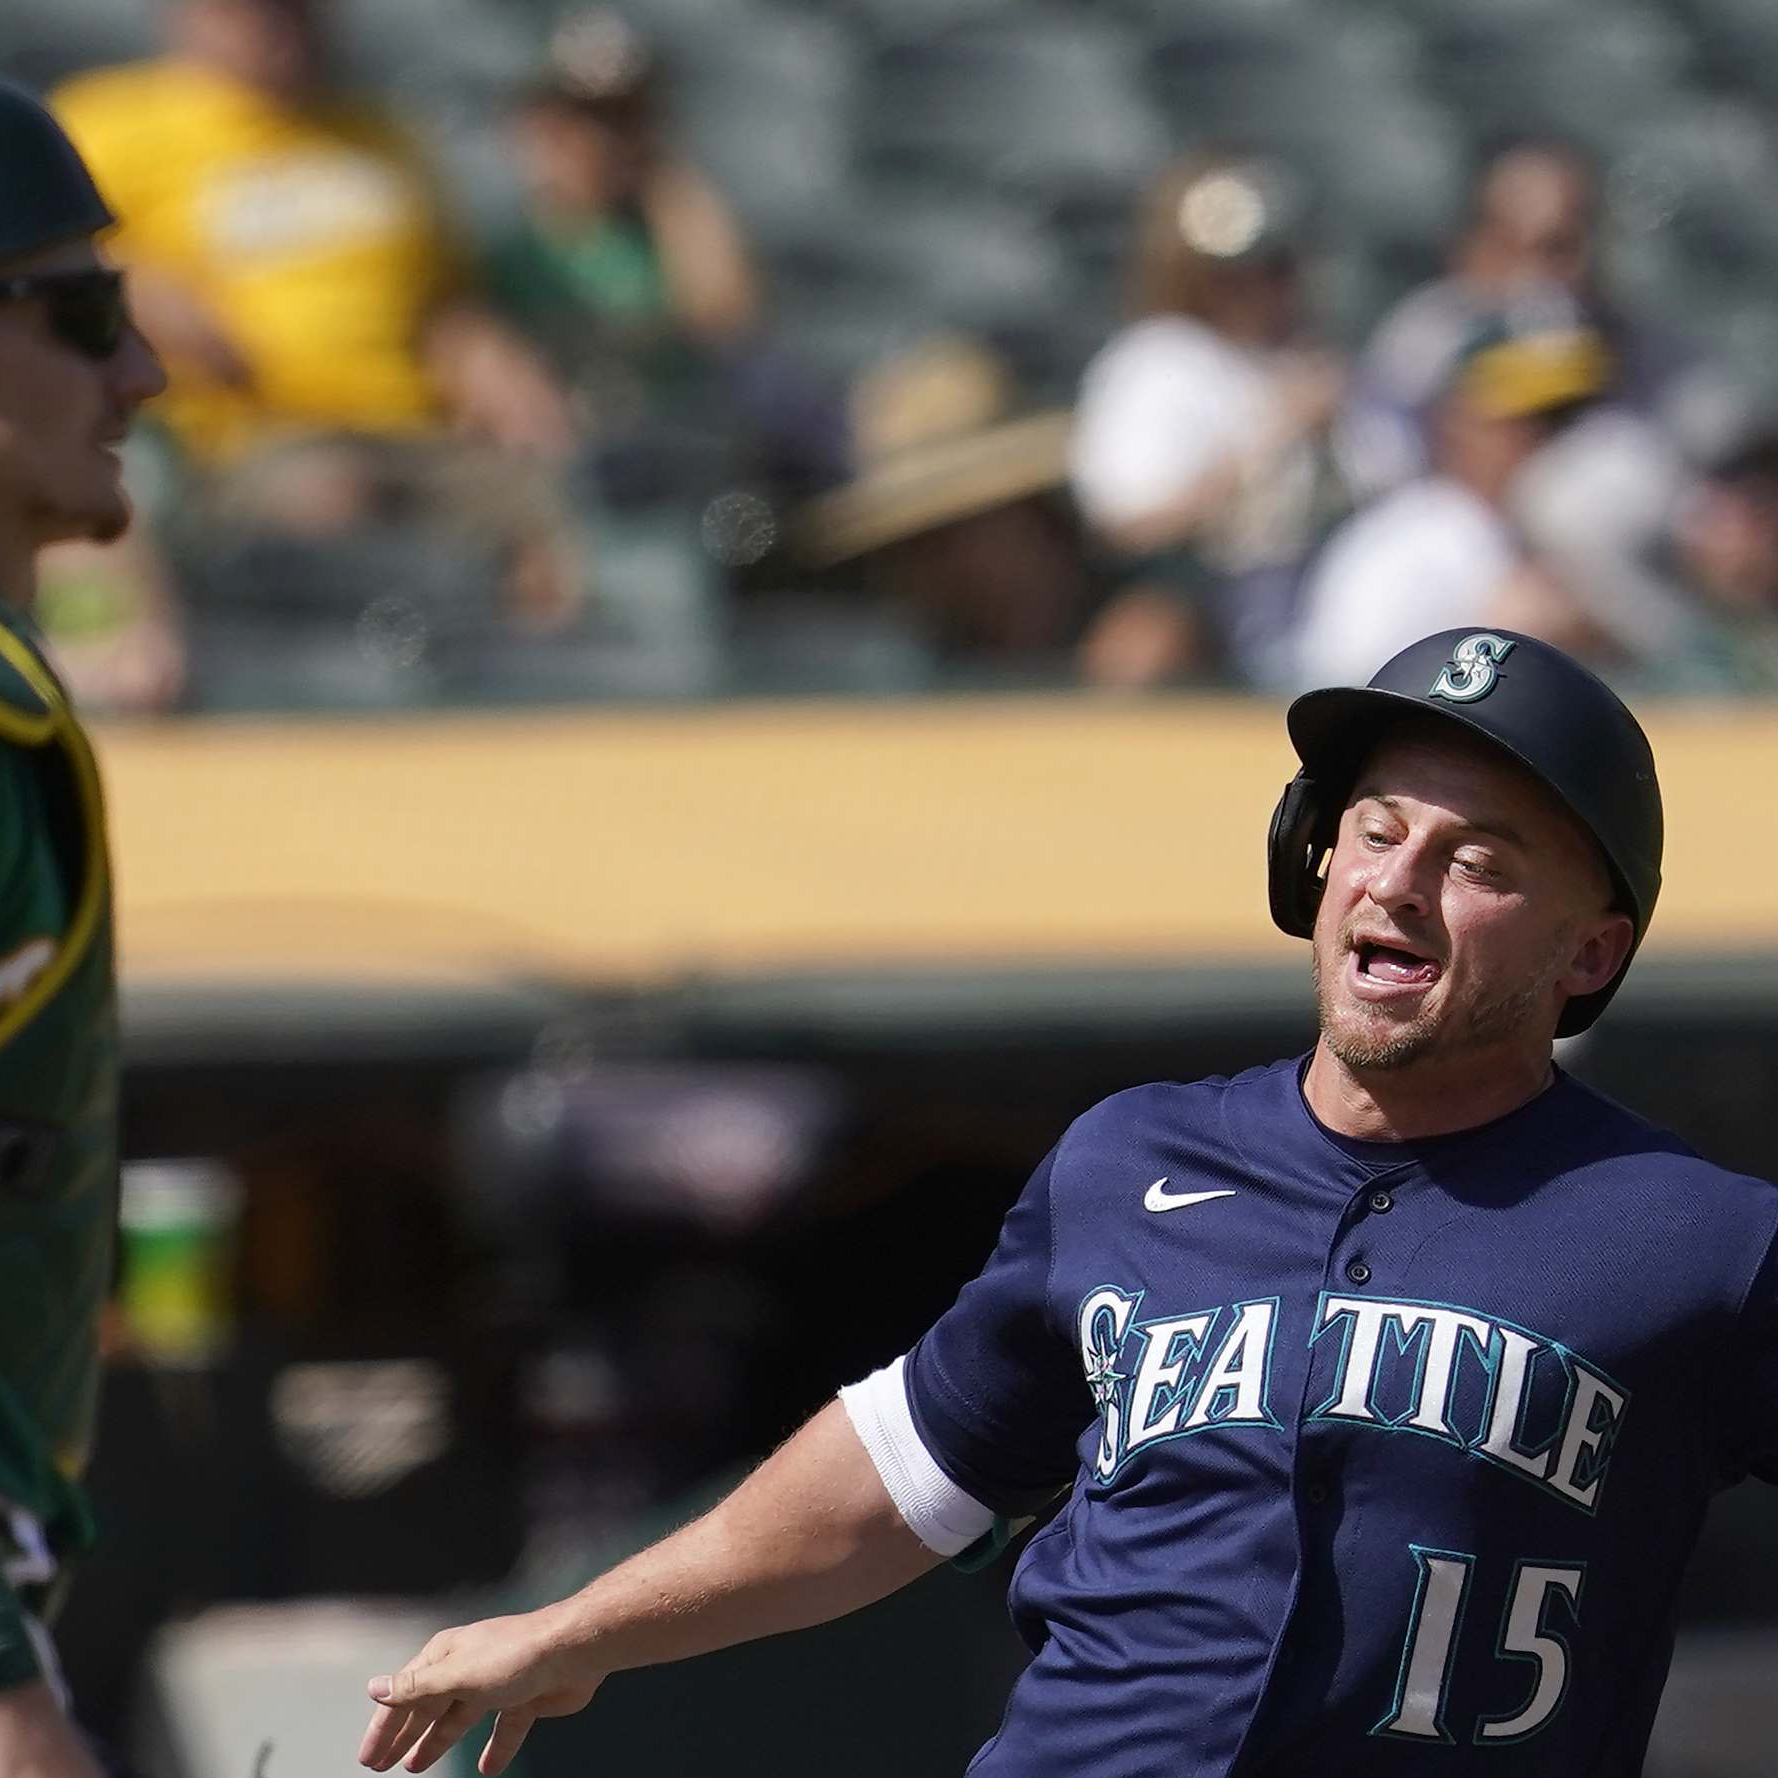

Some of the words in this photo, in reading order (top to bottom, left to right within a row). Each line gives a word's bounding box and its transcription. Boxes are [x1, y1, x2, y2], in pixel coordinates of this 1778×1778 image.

[1428, 632, 1516, 703] S
[1077, 1284, 1631, 1517] SEATTLE
[1369, 1543, 1587, 1745] 15
